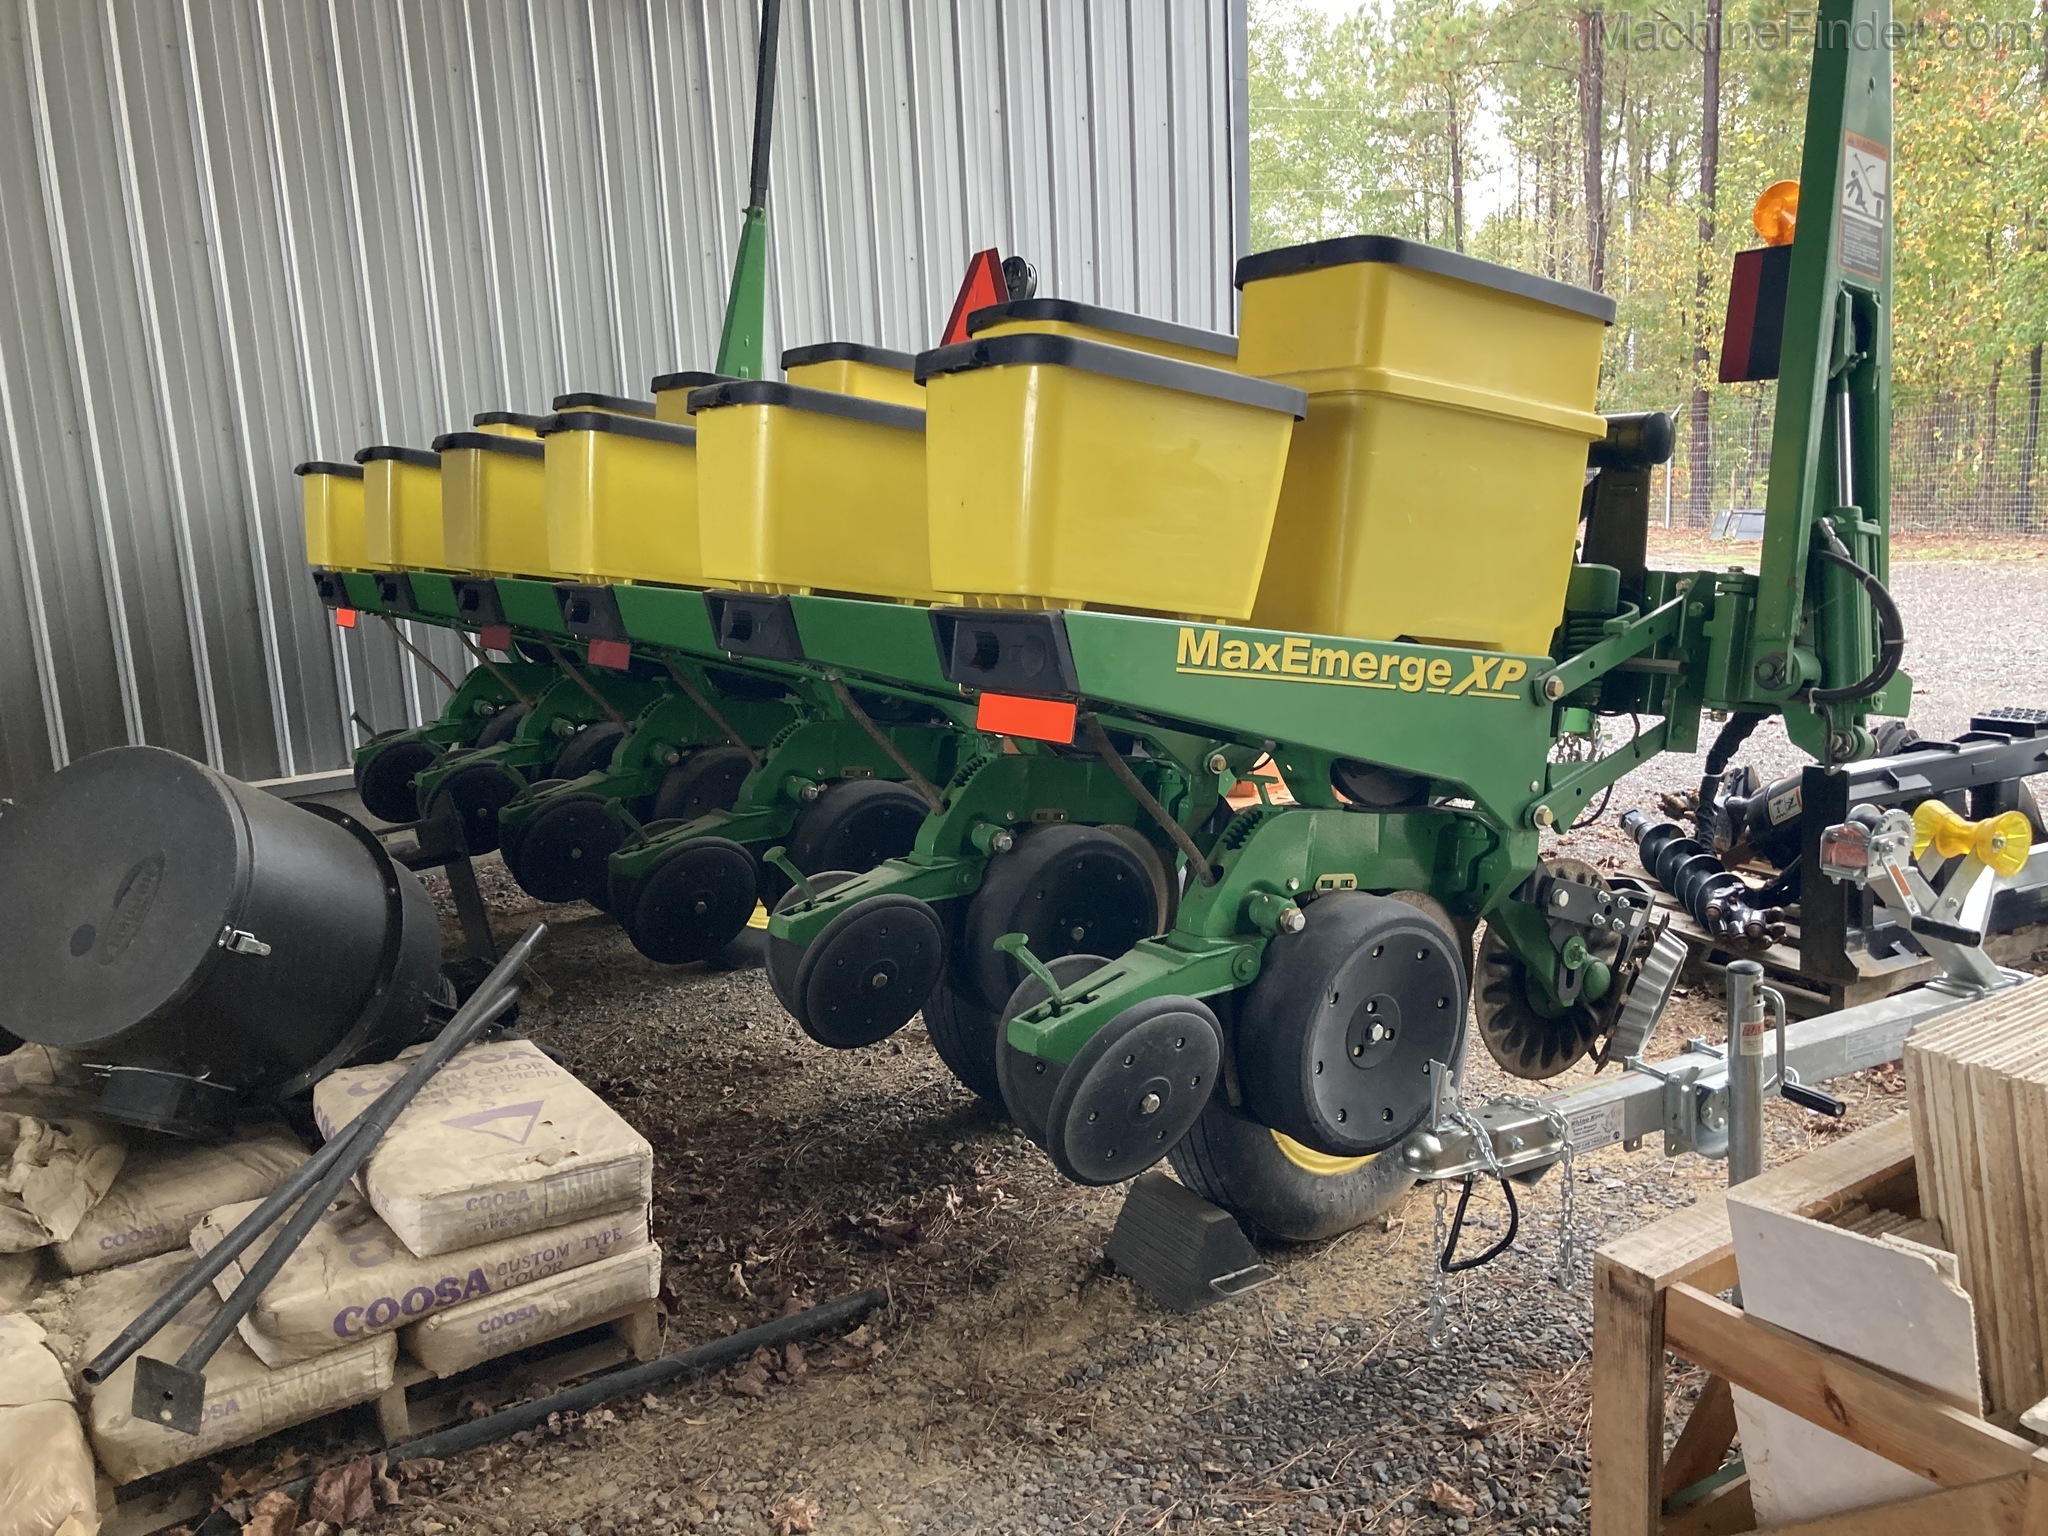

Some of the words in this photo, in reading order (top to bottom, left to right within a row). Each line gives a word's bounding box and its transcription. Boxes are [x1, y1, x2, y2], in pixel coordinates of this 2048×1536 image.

[1176, 627, 1452, 692] MaxEmerge
[1449, 655, 1528, 695] XP
[475, 1062, 546, 1080] COLOR
[478, 1068, 560, 1086] CEMENT
[466, 1188, 530, 1212] COOSA
[496, 1243, 570, 1276] CUSTOM
[581, 1227, 623, 1251] TYPE
[503, 1260, 563, 1288] COLOR
[333, 1268, 491, 1338] COOSA
[477, 1304, 540, 1335] COOSA
